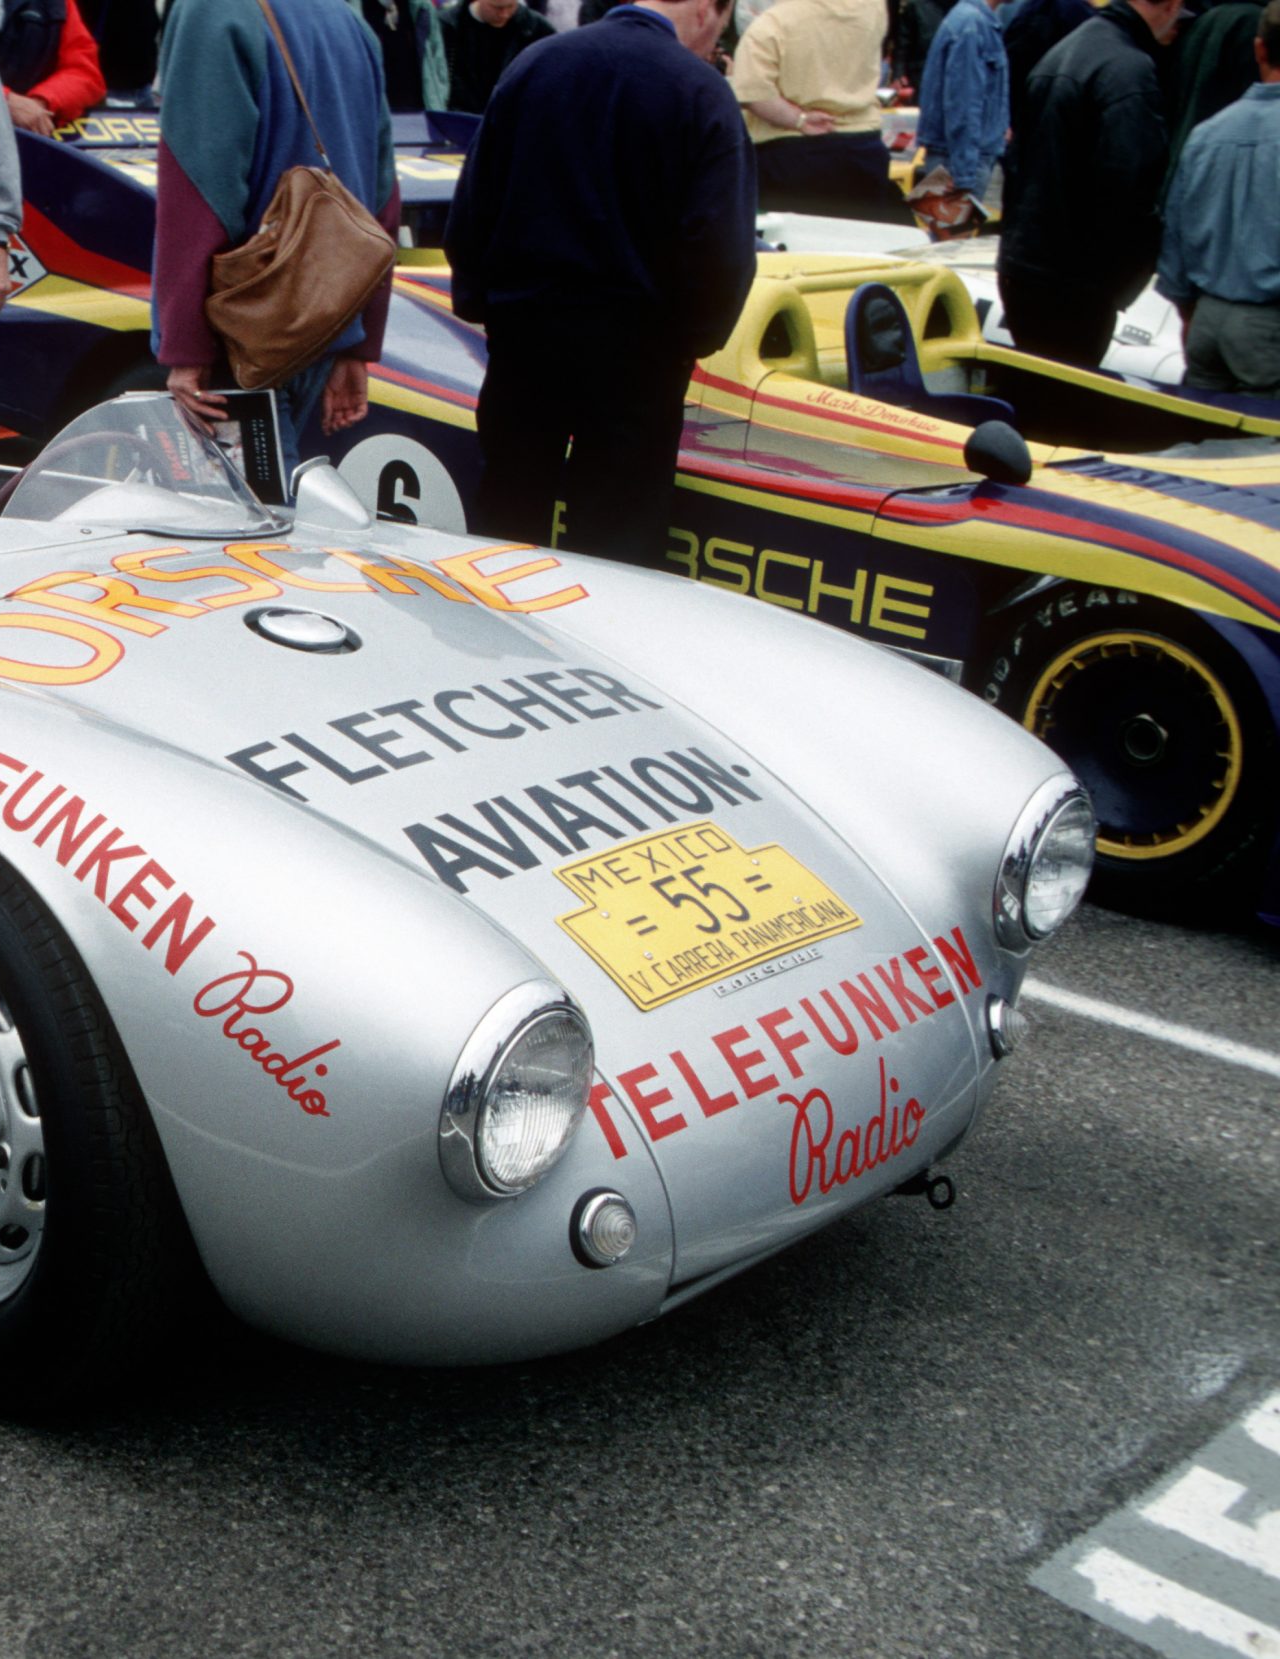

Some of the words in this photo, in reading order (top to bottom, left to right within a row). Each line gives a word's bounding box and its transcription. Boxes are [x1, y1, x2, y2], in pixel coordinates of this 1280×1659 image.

[224, 668, 665, 803] FLETCHER
[571, 828, 732, 896] MEXICO
[649, 864, 751, 934] 55
[628, 970, 655, 995] V
[653, 937, 740, 986] CARRERA
[729, 898, 848, 953] PANAMERICANA
[715, 946, 822, 997] PORSCHE
[192, 950, 342, 1118] Radio
[587, 926, 983, 1160] TELEFUNKEN
[777, 1055, 926, 1207] Radio
